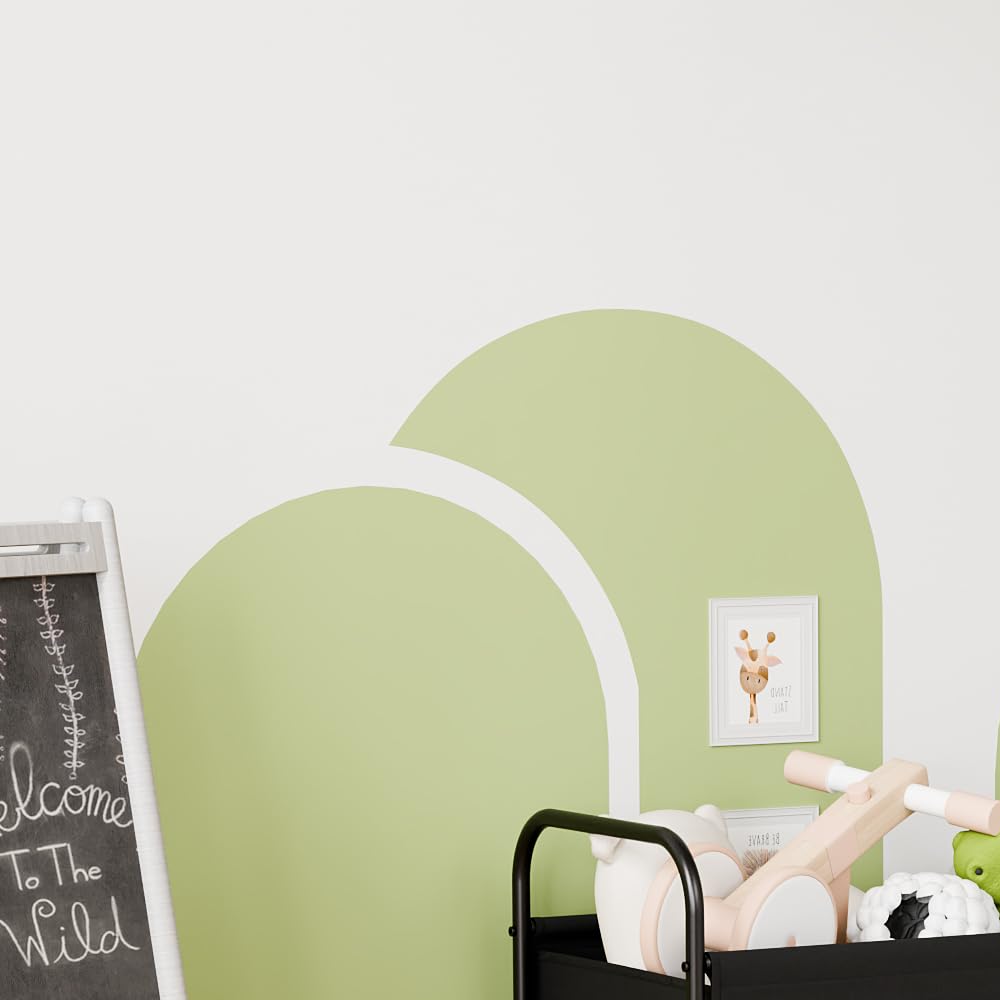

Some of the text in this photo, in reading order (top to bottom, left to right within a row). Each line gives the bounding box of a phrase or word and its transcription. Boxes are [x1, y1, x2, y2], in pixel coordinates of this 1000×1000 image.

[0, 740, 134, 832] elcome
[37, 842, 103, 886] The
[0, 895, 141, 967] Wild
